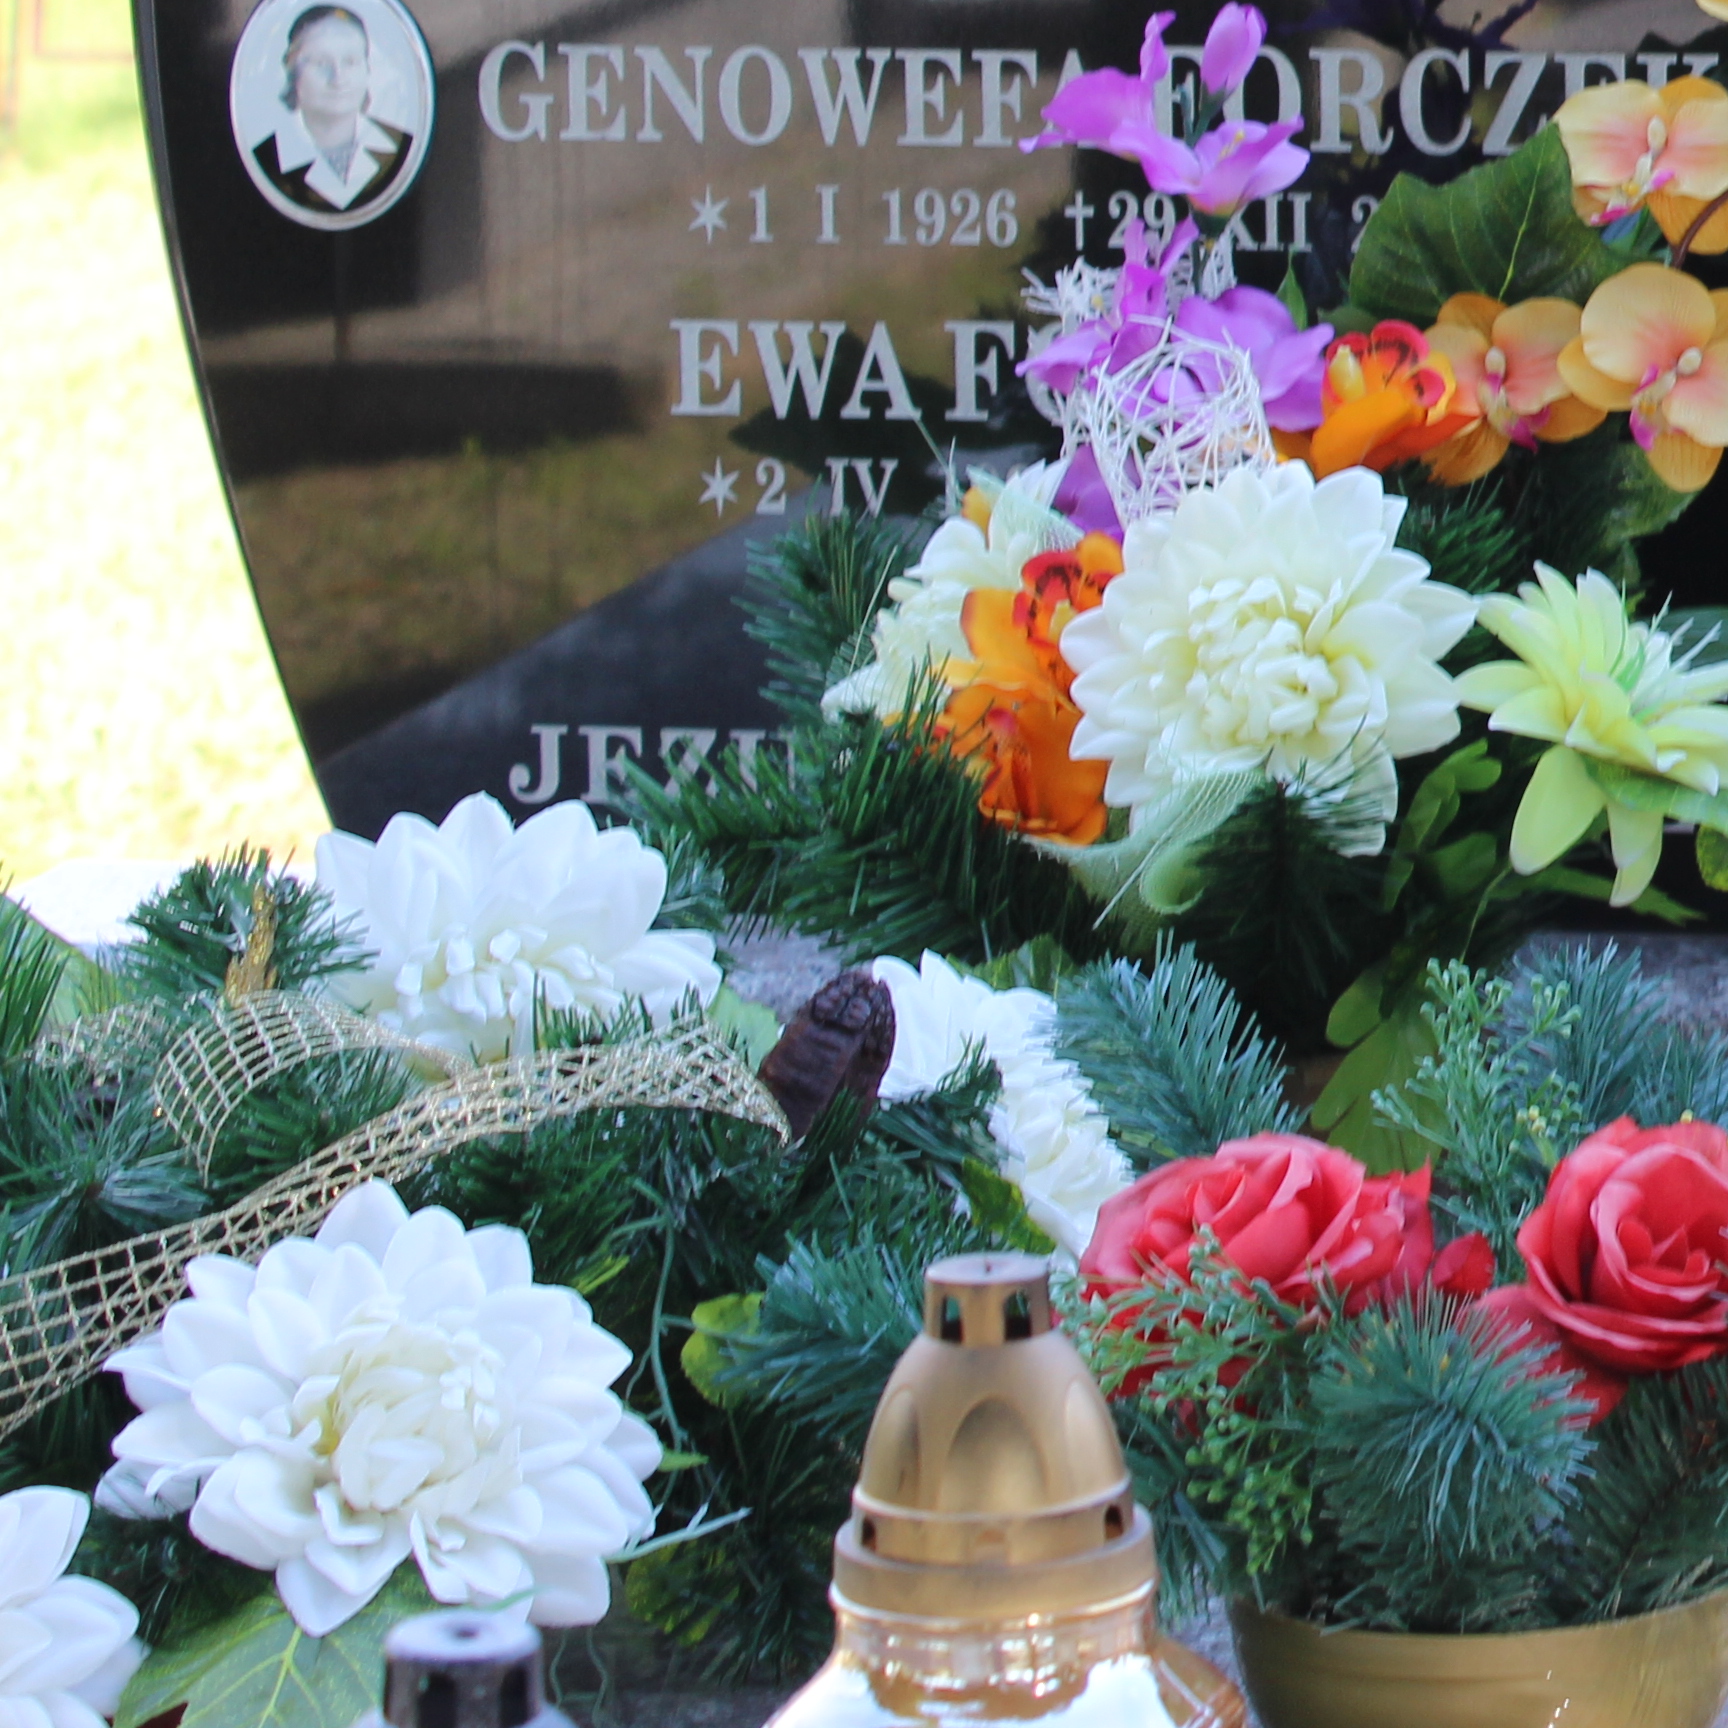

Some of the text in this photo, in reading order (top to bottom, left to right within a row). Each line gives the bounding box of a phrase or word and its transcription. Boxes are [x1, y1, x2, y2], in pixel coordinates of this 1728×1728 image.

[1153, 45, 1719, 157] FORCZ
[747, 184, 774, 244] 1
[814, 183, 840, 245] I
[882, 187, 1019, 249] 1926
[670, 319, 921, 420] EWA
[756, 458, 787, 514] 2
[825, 457, 898, 515] IV
